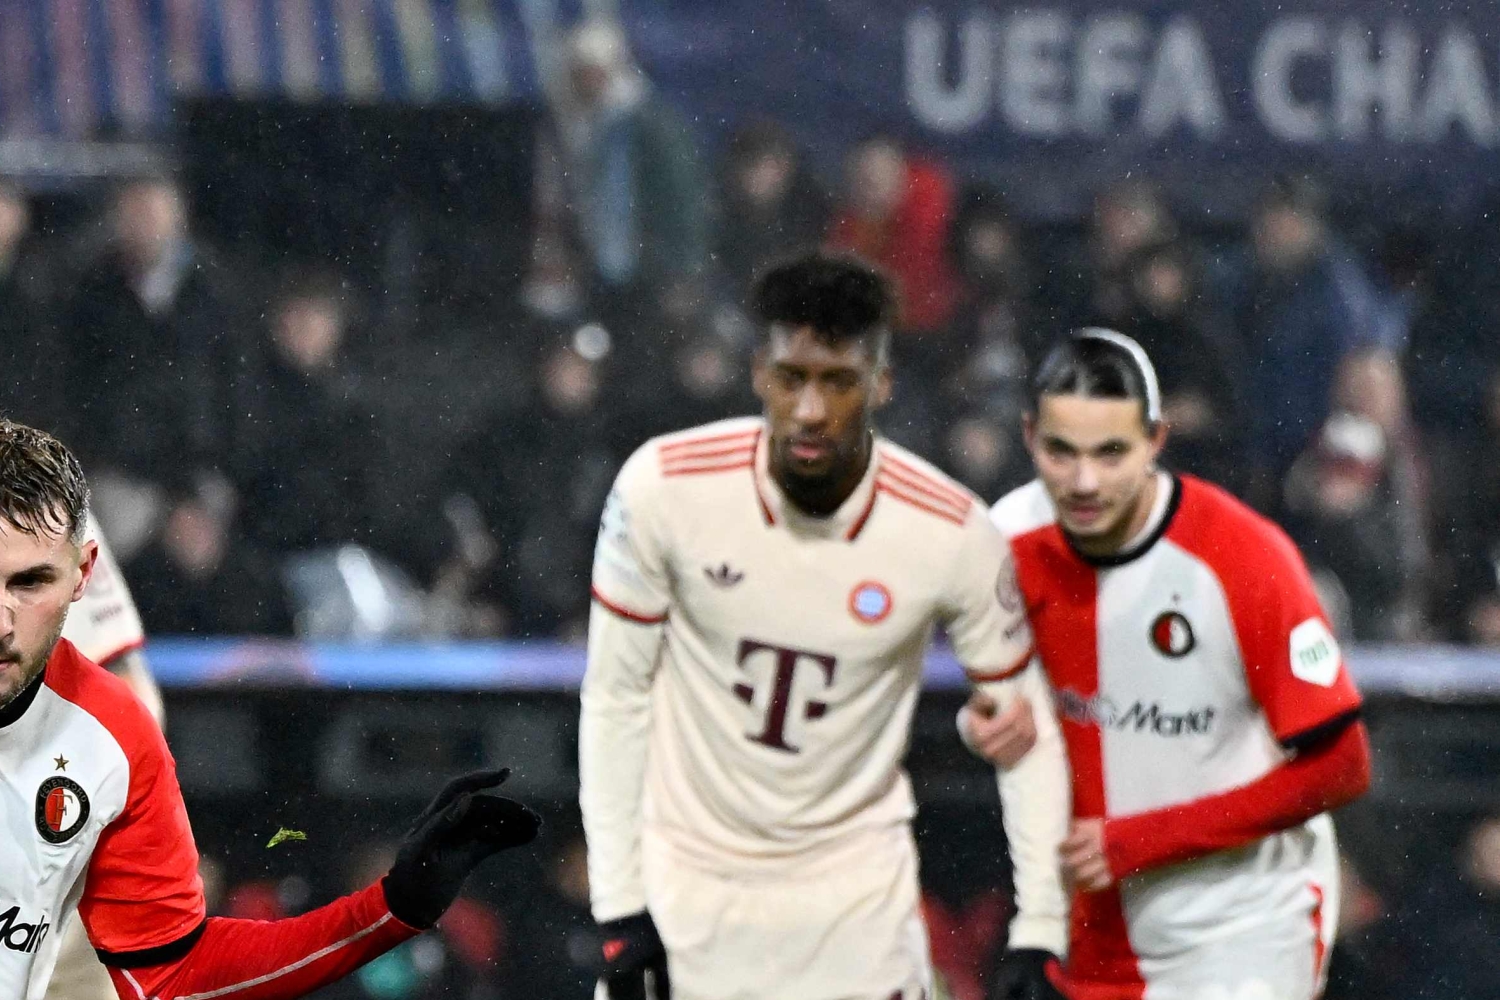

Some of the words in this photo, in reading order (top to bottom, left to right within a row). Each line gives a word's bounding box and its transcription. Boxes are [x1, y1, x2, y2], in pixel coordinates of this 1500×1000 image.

[903, 8, 1227, 137] UEFA
[1252, 18, 1499, 146] CHA
[733, 640, 837, 754] T
[40, 779, 88, 803] FEYENOORD
